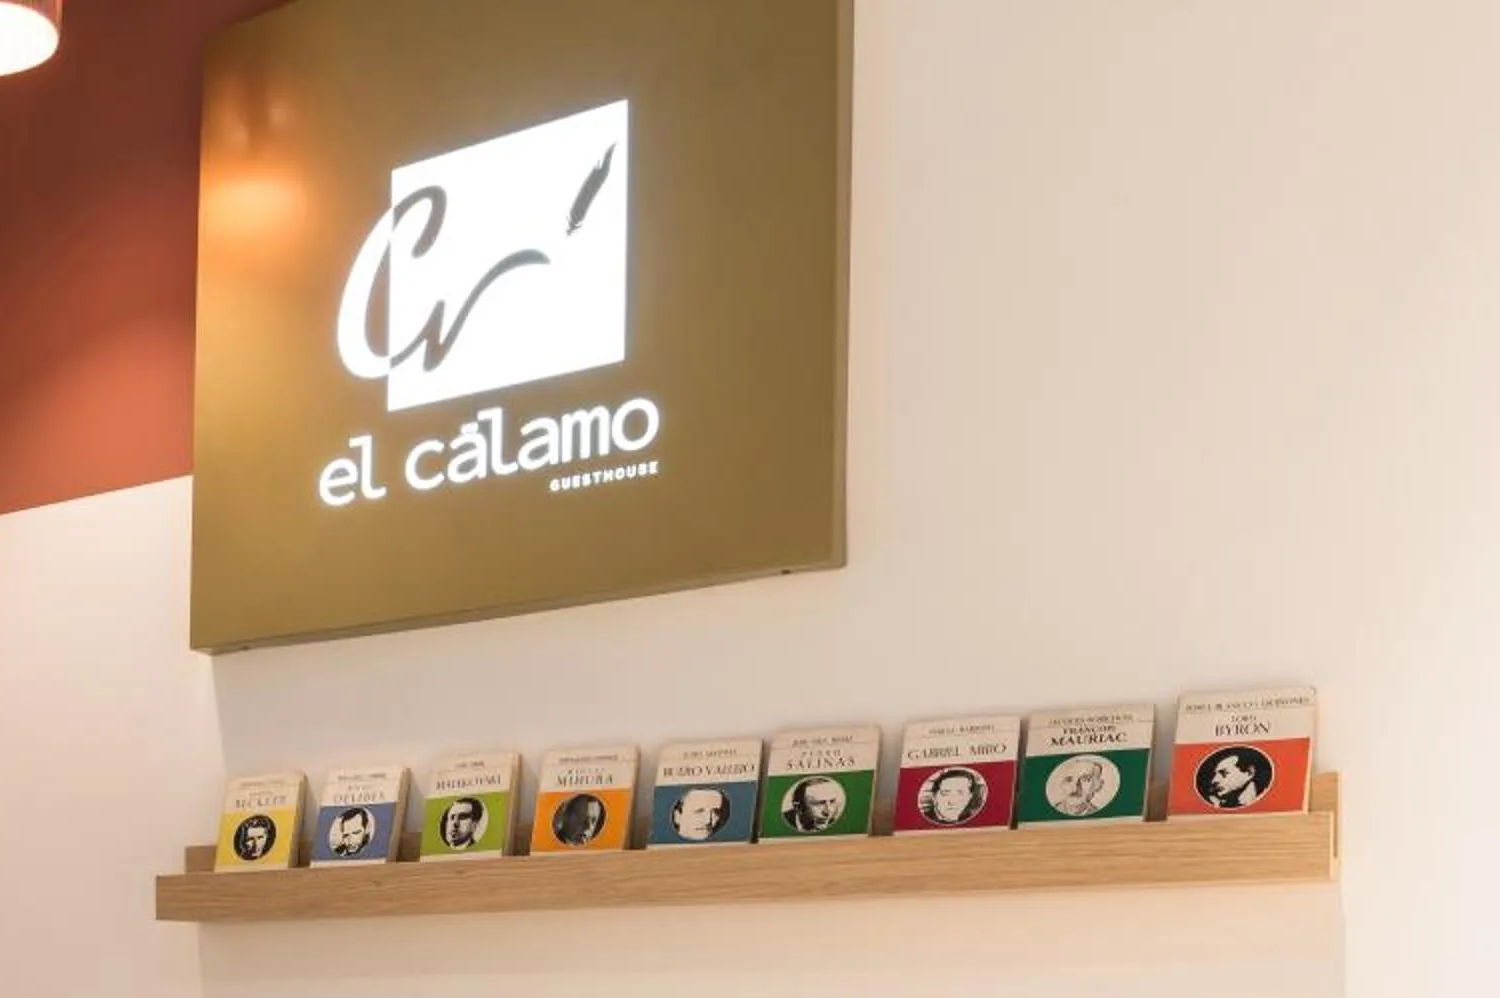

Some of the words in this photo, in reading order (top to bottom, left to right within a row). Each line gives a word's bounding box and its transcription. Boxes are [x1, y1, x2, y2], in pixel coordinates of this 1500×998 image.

[318, 435, 387, 506] el
[404, 398, 660, 490] cálamo
[549, 461, 660, 492] GUESTHOUSE
[1215, 722, 1270, 736] BYRON
[1051, 731, 1127, 745] MAURIAC
[788, 756, 854, 769] SALINAS
